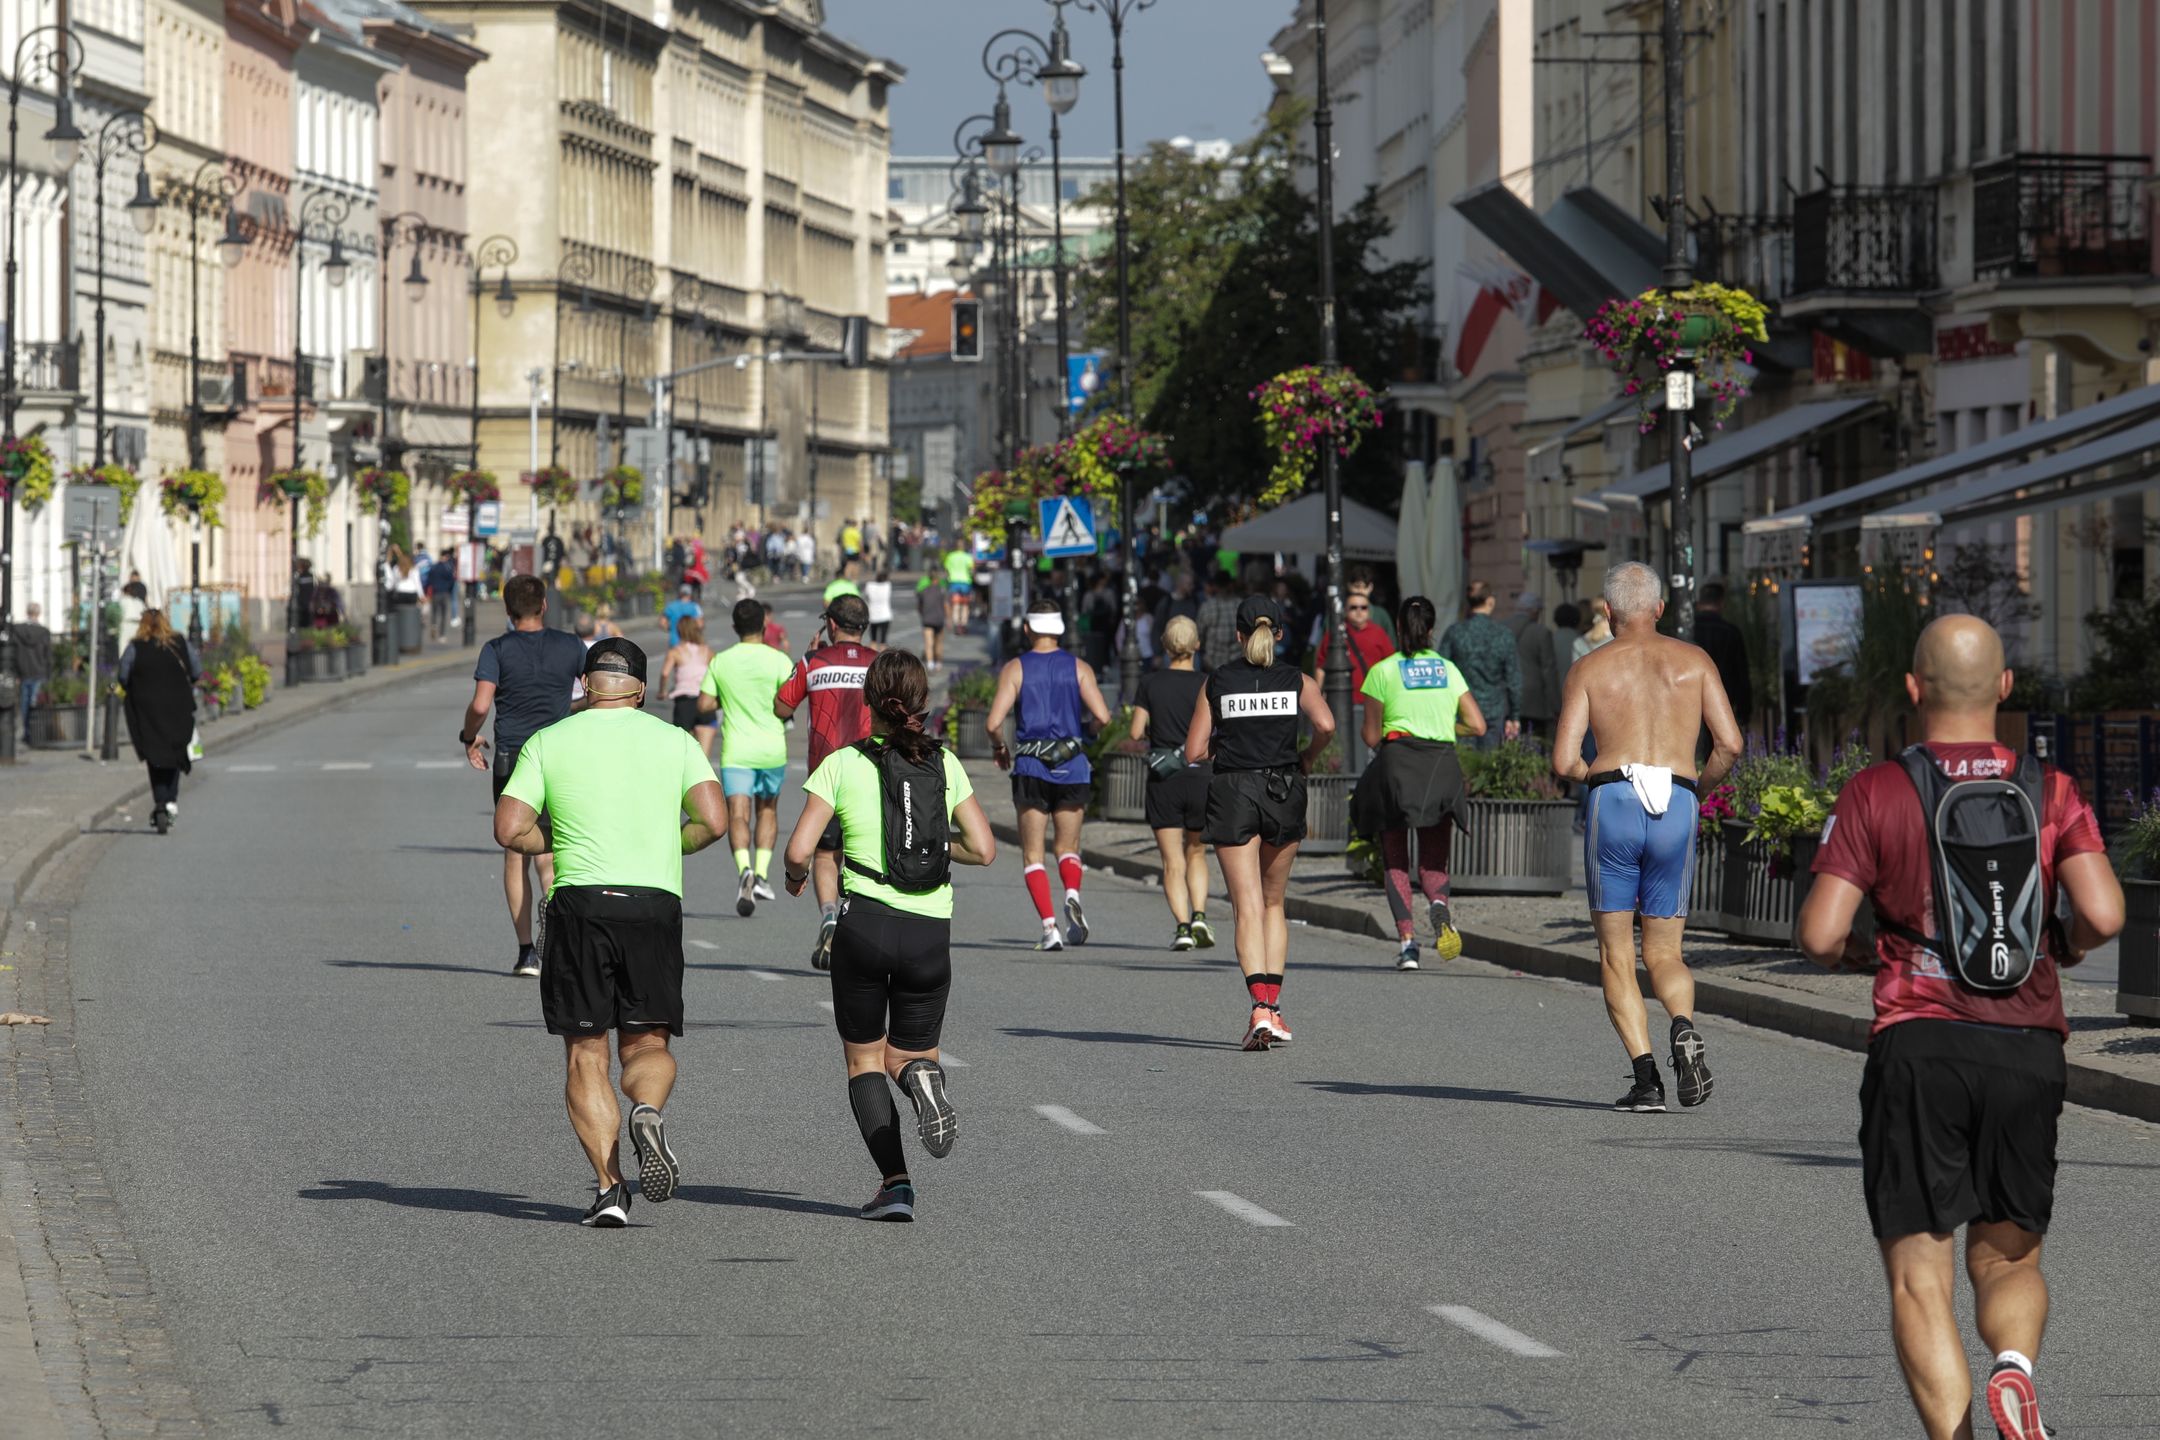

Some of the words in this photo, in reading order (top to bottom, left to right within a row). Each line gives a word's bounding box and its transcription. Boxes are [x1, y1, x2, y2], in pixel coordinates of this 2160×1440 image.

[1228, 697, 1289, 712] RUNNER
[903, 781, 913, 850] ROCKRIDER
[1989, 881, 2005, 939] Kalenji
